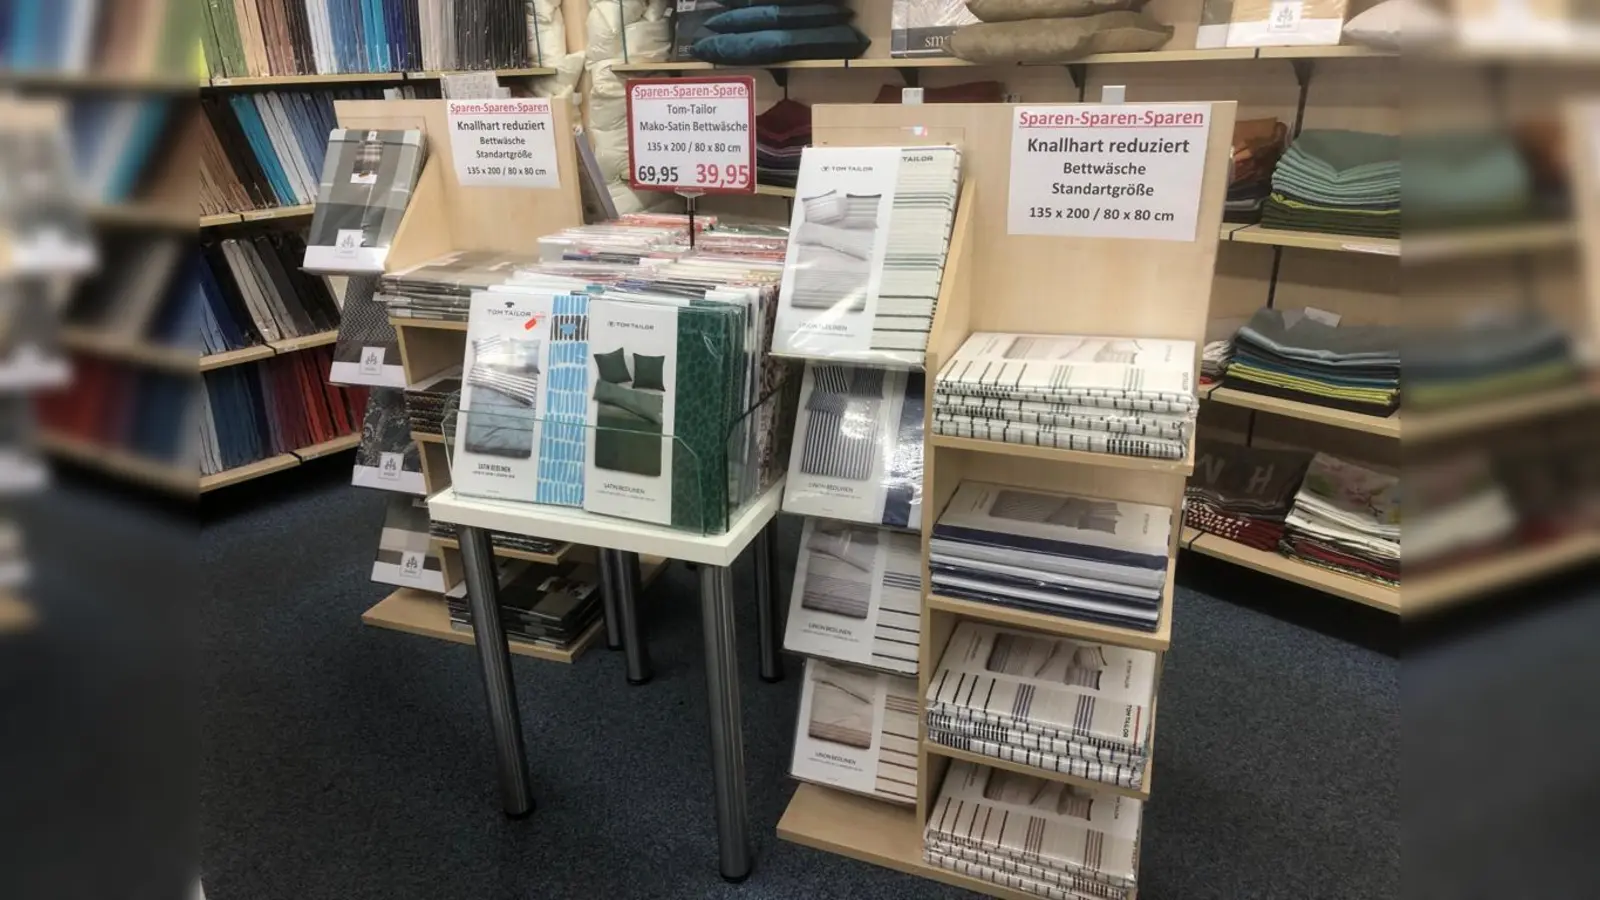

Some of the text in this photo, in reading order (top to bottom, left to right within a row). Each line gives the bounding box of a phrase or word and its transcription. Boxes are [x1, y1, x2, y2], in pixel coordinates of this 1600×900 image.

[450, 103, 549, 114] Sparen-Sparen-Sparen
[667, 104, 717, 115] Tom-Tailor
[1019, 110, 1204, 127] Sparen-Sparen-Sparen
[457, 120, 545, 130] Knallhart reduziert
[639, 121, 748, 132] Mako-Satin Bettwäsche
[479, 136, 526, 145] Bettwäsche
[1028, 138, 1190, 153] Knallhart reduziert
[647, 142, 661, 151] 135
[671, 142, 686, 152] 200
[688, 142, 692, 153] /
[695, 143, 705, 152] 80
[714, 143, 725, 153] 80
[476, 150, 532, 160] Standartgröße
[467, 167, 480, 175] 135
[487, 167, 500, 175] 200
[507, 167, 517, 175] 80
[524, 167, 533, 175] 80
[1063, 162, 1146, 175] Bettwäsche
[638, 164, 749, 188] 69,95 39,95
[1052, 182, 1154, 198] Standartgröße
[1029, 207, 1174, 221] 135 x 200 / 80 x 80 cm
